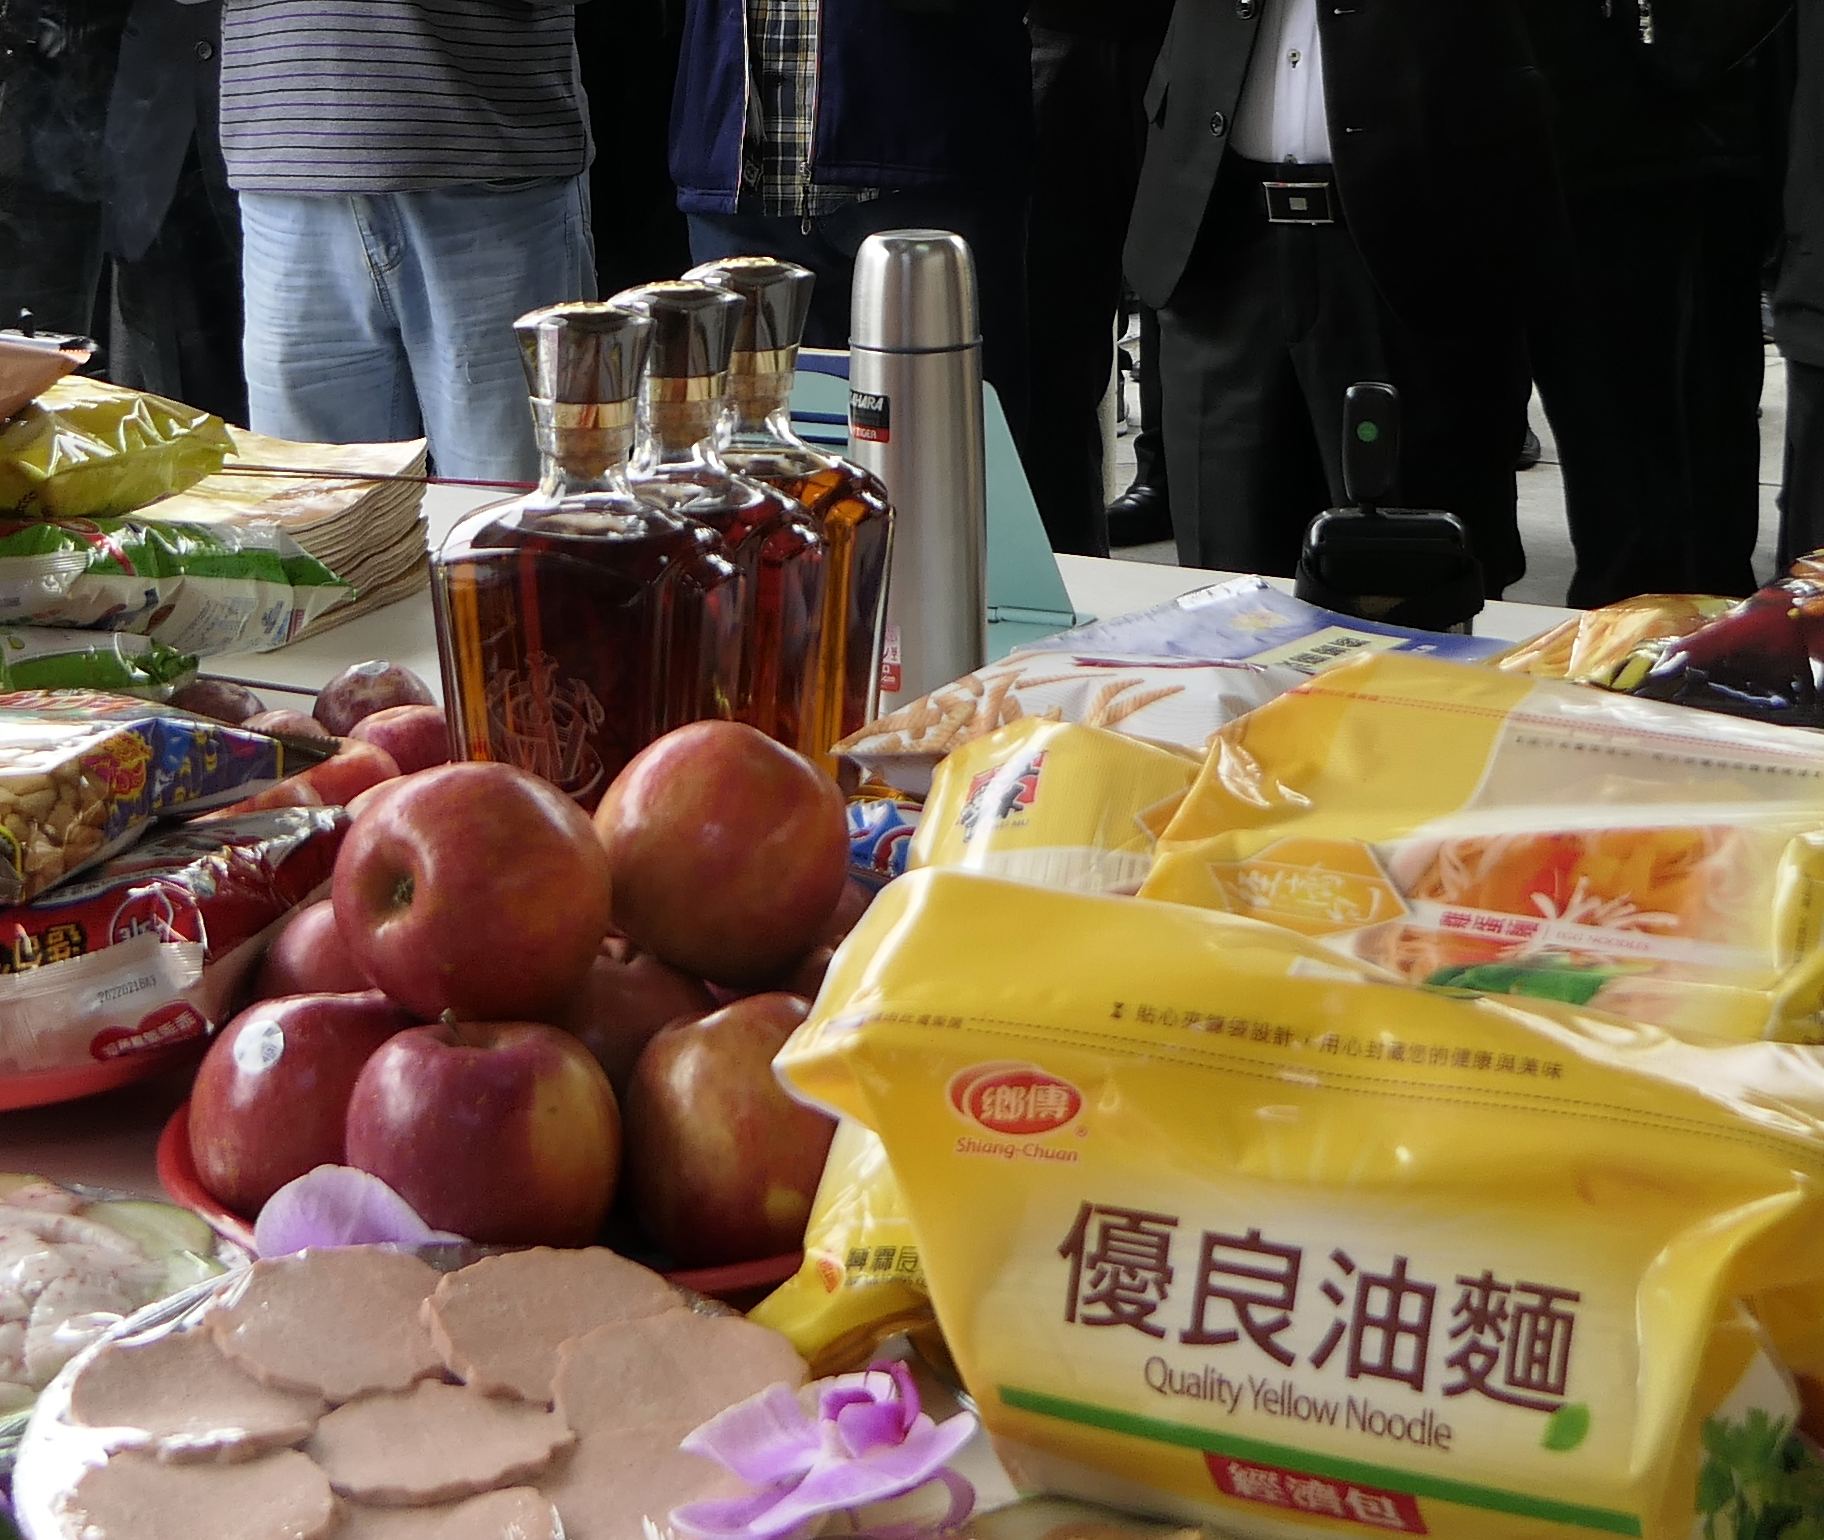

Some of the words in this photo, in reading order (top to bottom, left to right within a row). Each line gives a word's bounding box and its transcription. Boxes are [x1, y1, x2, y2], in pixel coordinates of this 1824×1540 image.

[955, 1135, 1080, 1164] Shiang-Chuan
[1057, 1200, 1581, 1414] 優良油麵
[1143, 1356, 1245, 1416] Quality
[1248, 1374, 1339, 1426] Yellow
[1346, 1395, 1455, 1451] Noodle
[1228, 1462, 1406, 1531] 經濟包
